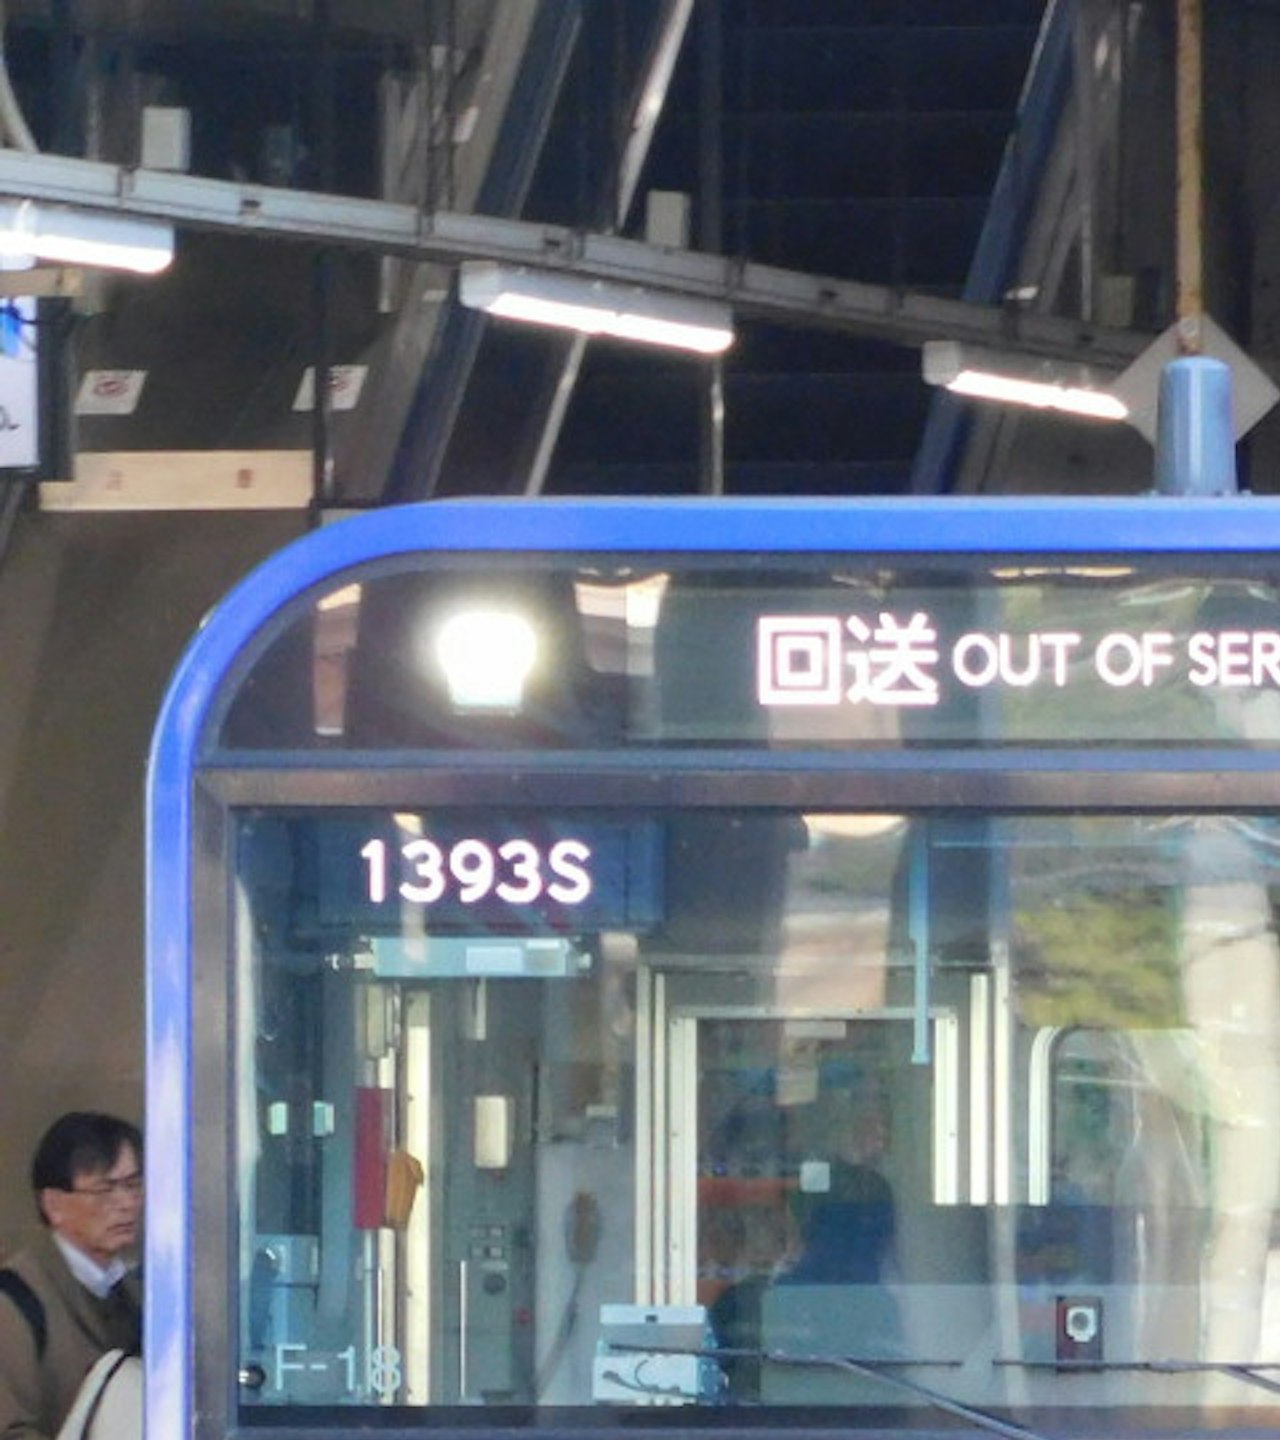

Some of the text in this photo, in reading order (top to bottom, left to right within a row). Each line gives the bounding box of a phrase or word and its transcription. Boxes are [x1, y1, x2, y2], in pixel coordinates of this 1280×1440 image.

[757, 612, 939, 706] 回送
[952, 631, 1080, 687] OUT
[1094, 631, 1174, 687] OF
[360, 838, 592, 904] 1393S
[275, 1343, 402, 1393] F-18
